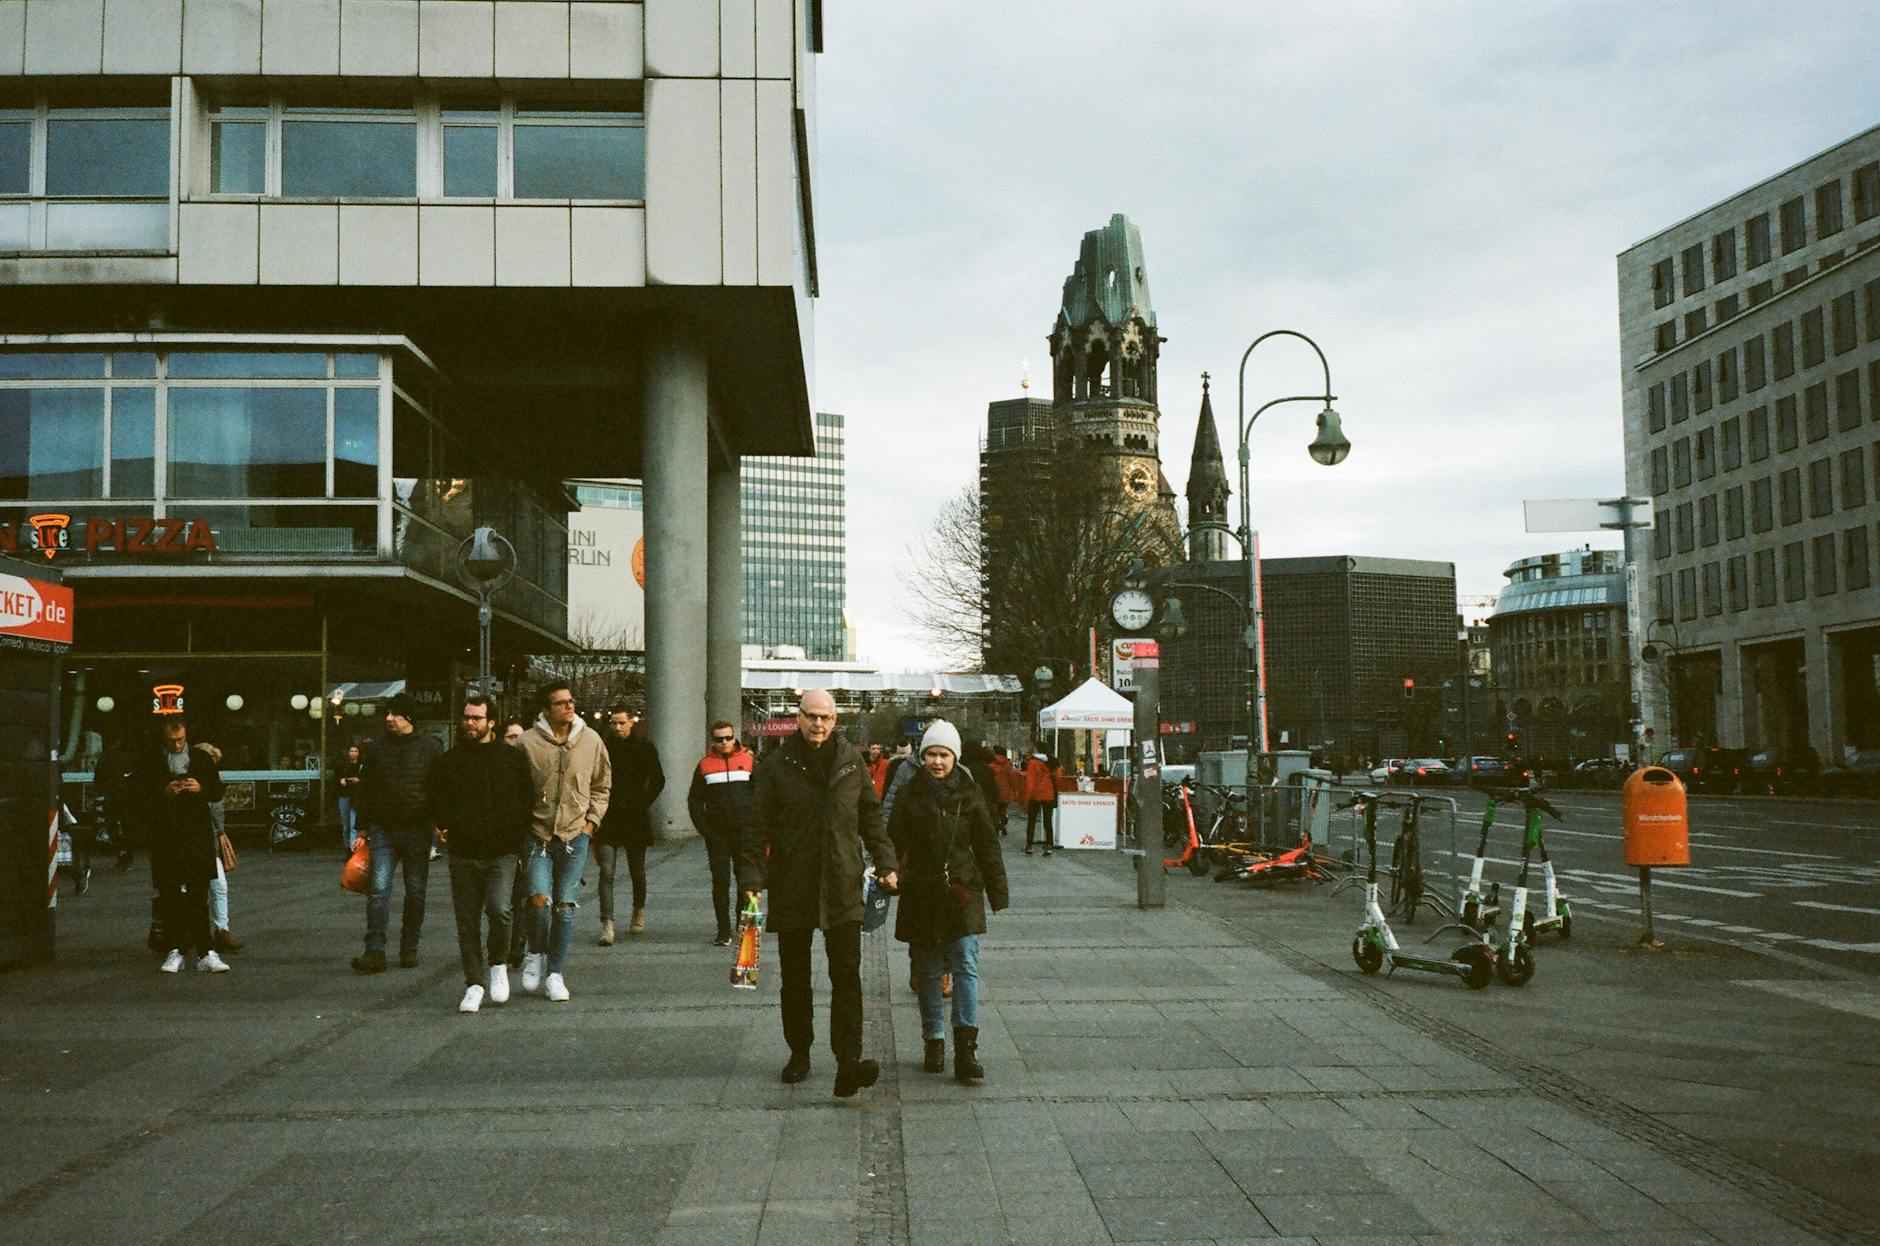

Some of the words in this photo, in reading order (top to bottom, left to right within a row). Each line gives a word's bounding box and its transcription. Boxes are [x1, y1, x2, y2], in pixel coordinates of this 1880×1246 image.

[87, 517, 216, 553] PIZZA
[568, 529, 596, 547] INI
[568, 548, 610, 567] RLIN
